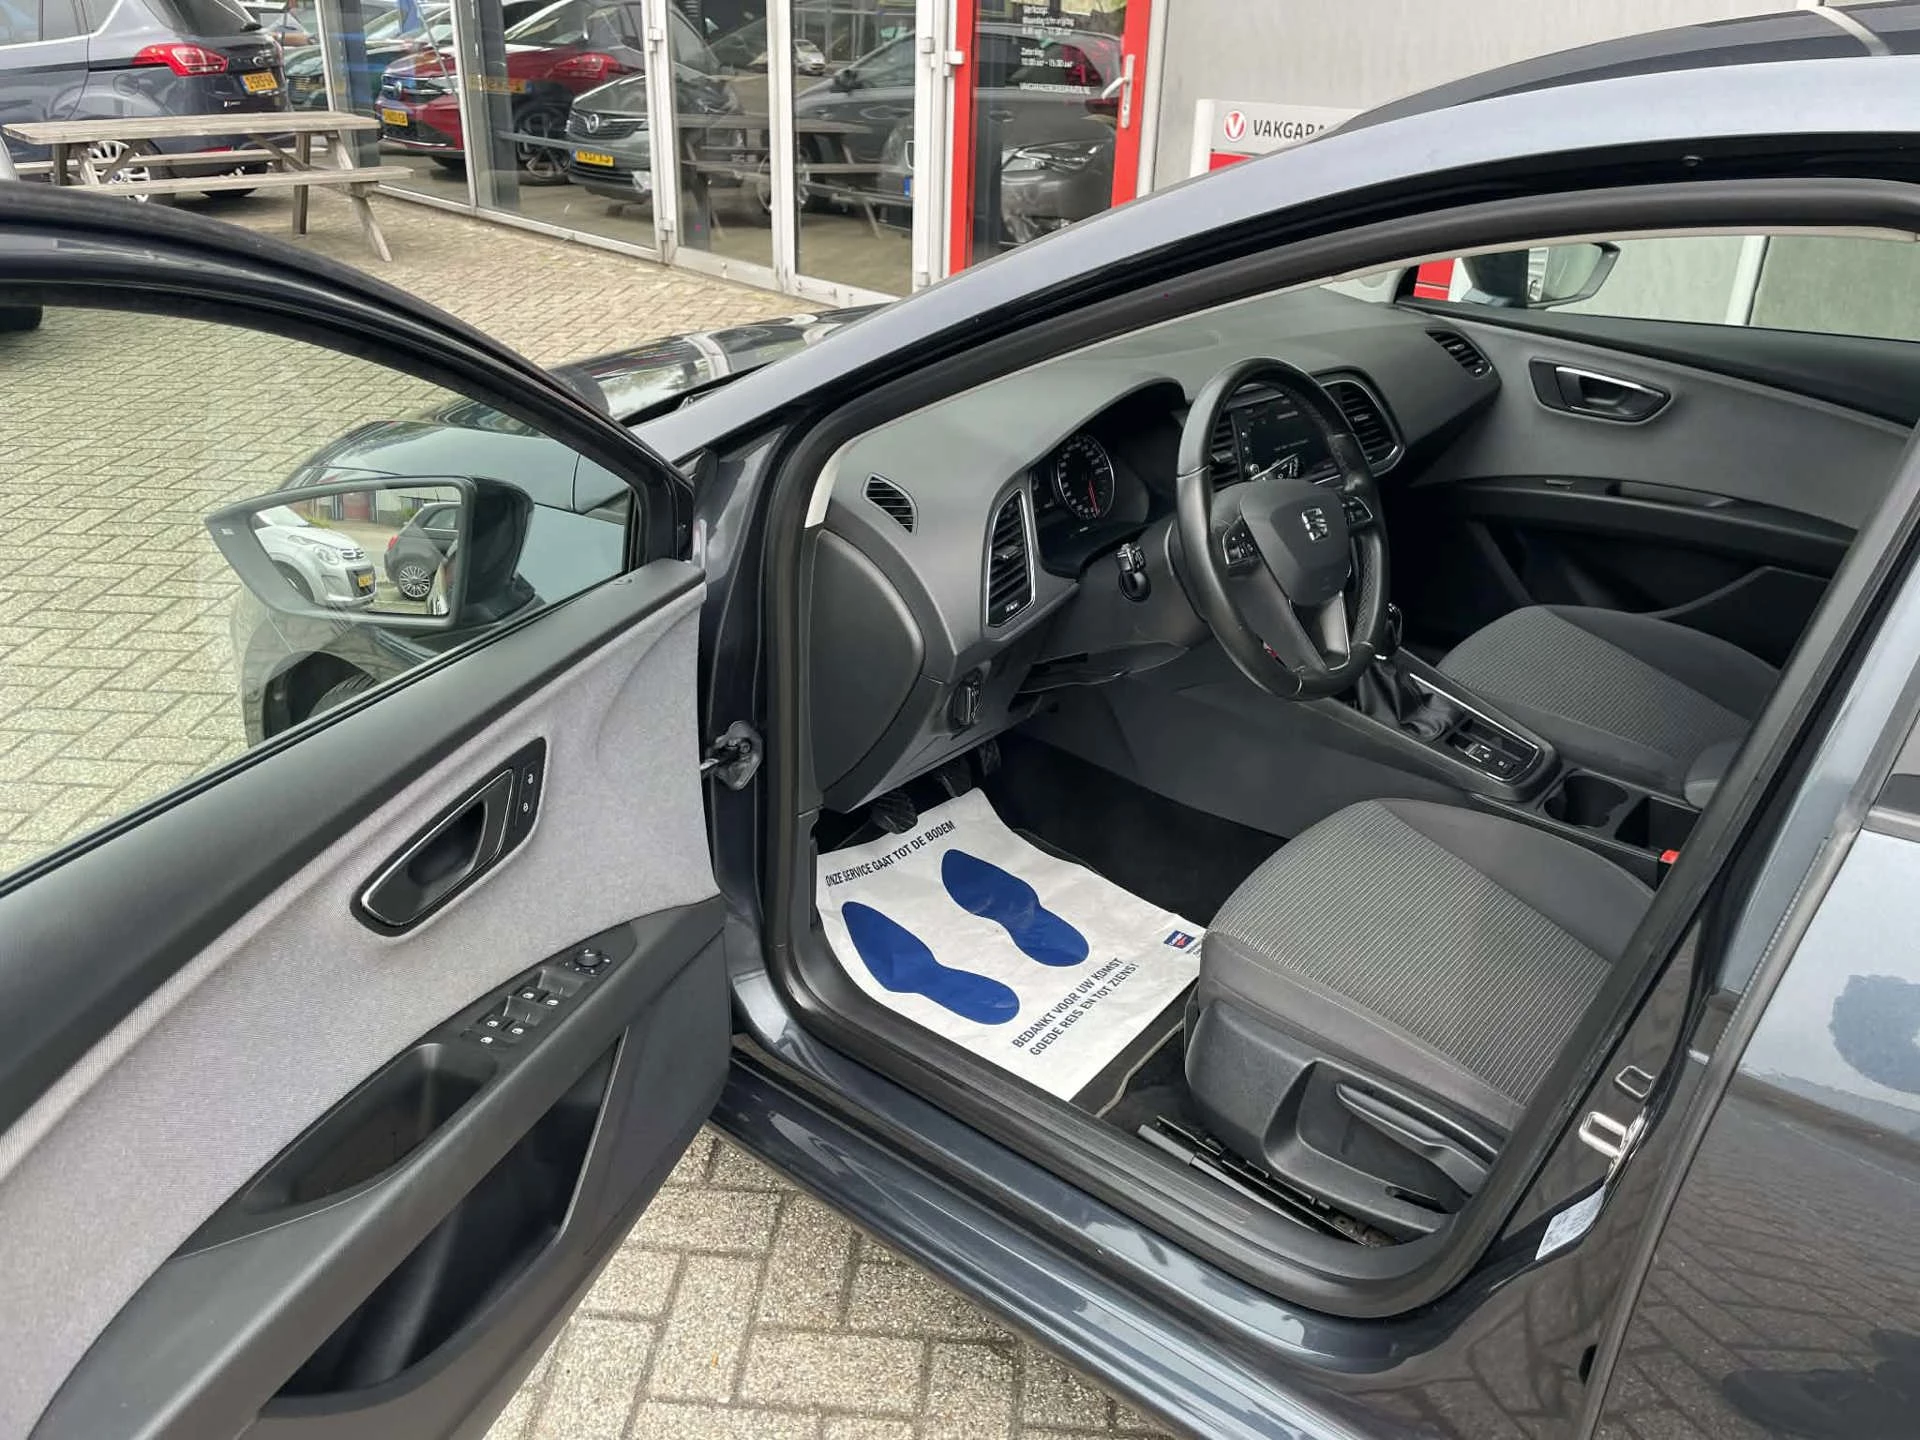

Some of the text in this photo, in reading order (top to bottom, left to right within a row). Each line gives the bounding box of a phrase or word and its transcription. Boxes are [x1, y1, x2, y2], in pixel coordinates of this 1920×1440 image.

[1253, 119, 1325, 140] VAKGAR
[825, 820, 956, 887] ONZE SERVICE GAAT TOT DE BODEM
[1012, 957, 1123, 1048] BEDANKT VOOR UW KOMST
[1029, 963, 1139, 1056] GOEDE REIS EN TOT ZIENS!
